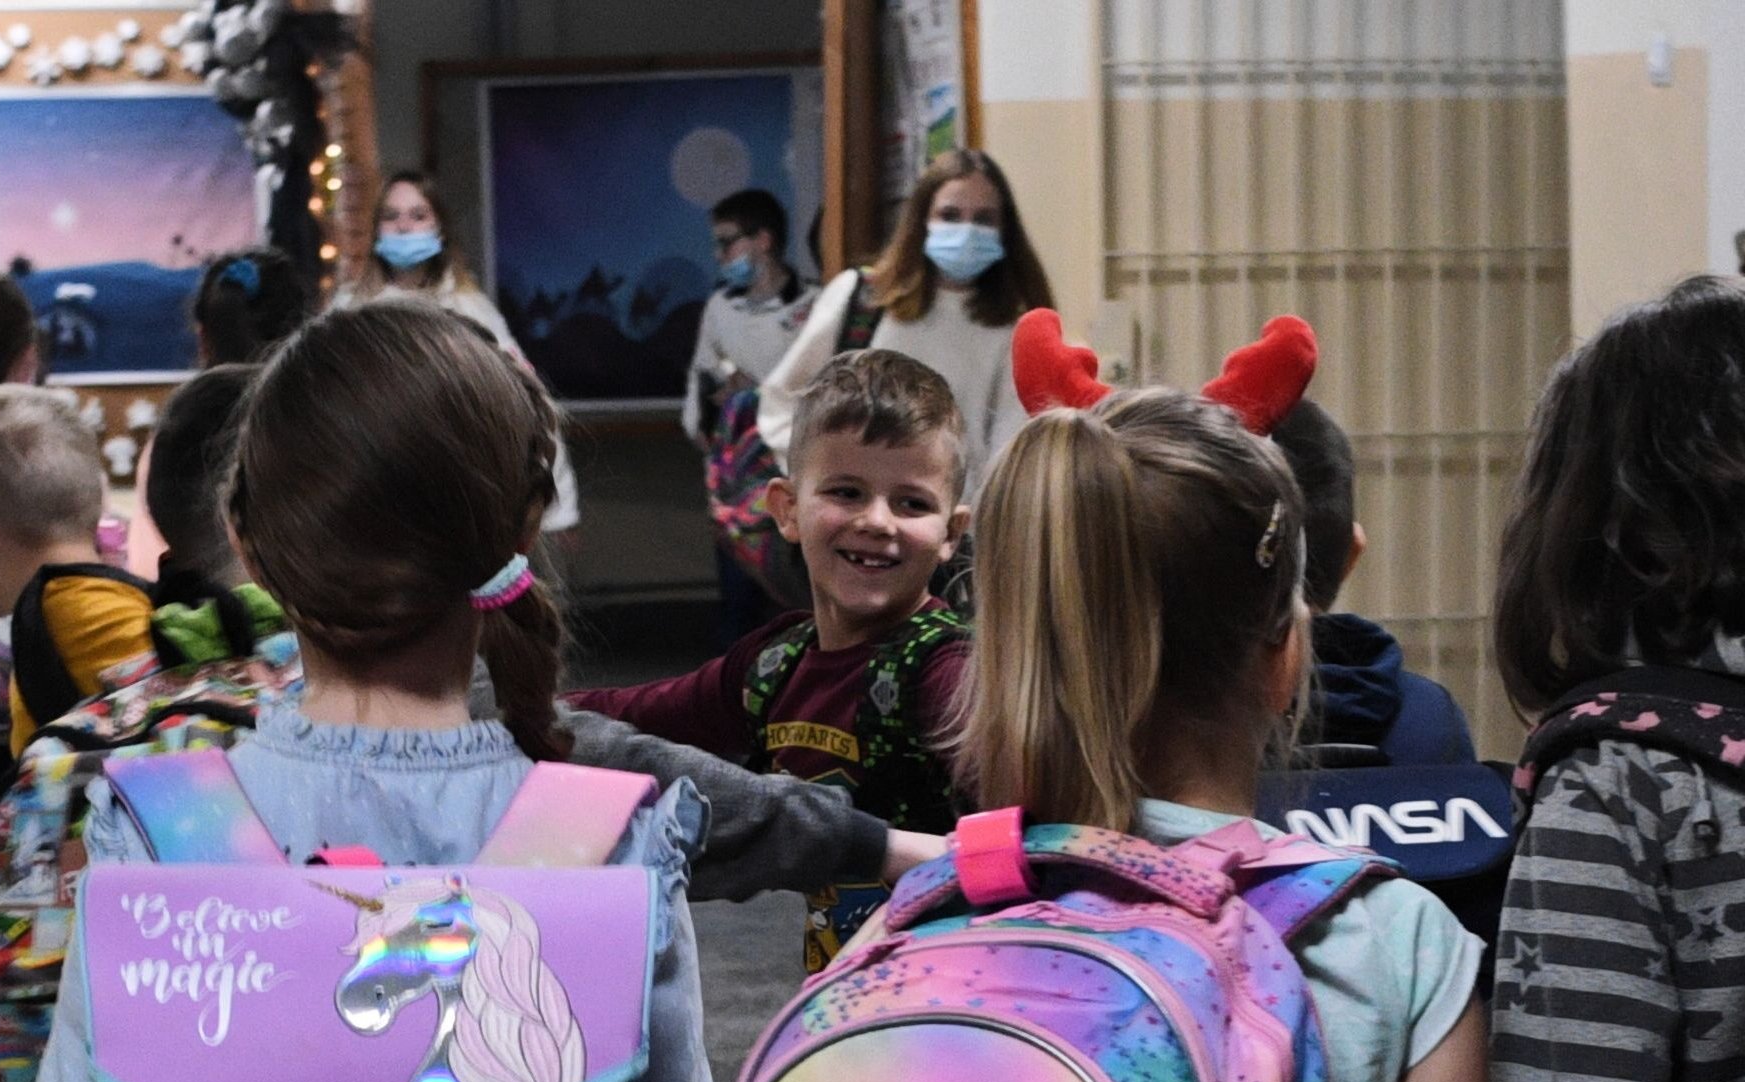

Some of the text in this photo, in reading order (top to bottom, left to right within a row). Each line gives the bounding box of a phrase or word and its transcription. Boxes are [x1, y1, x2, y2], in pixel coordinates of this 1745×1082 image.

[1286, 797, 1509, 848] NASA
[121, 892, 298, 939] Believe
[172, 928, 236, 960] in
[121, 950, 284, 1047] magic
